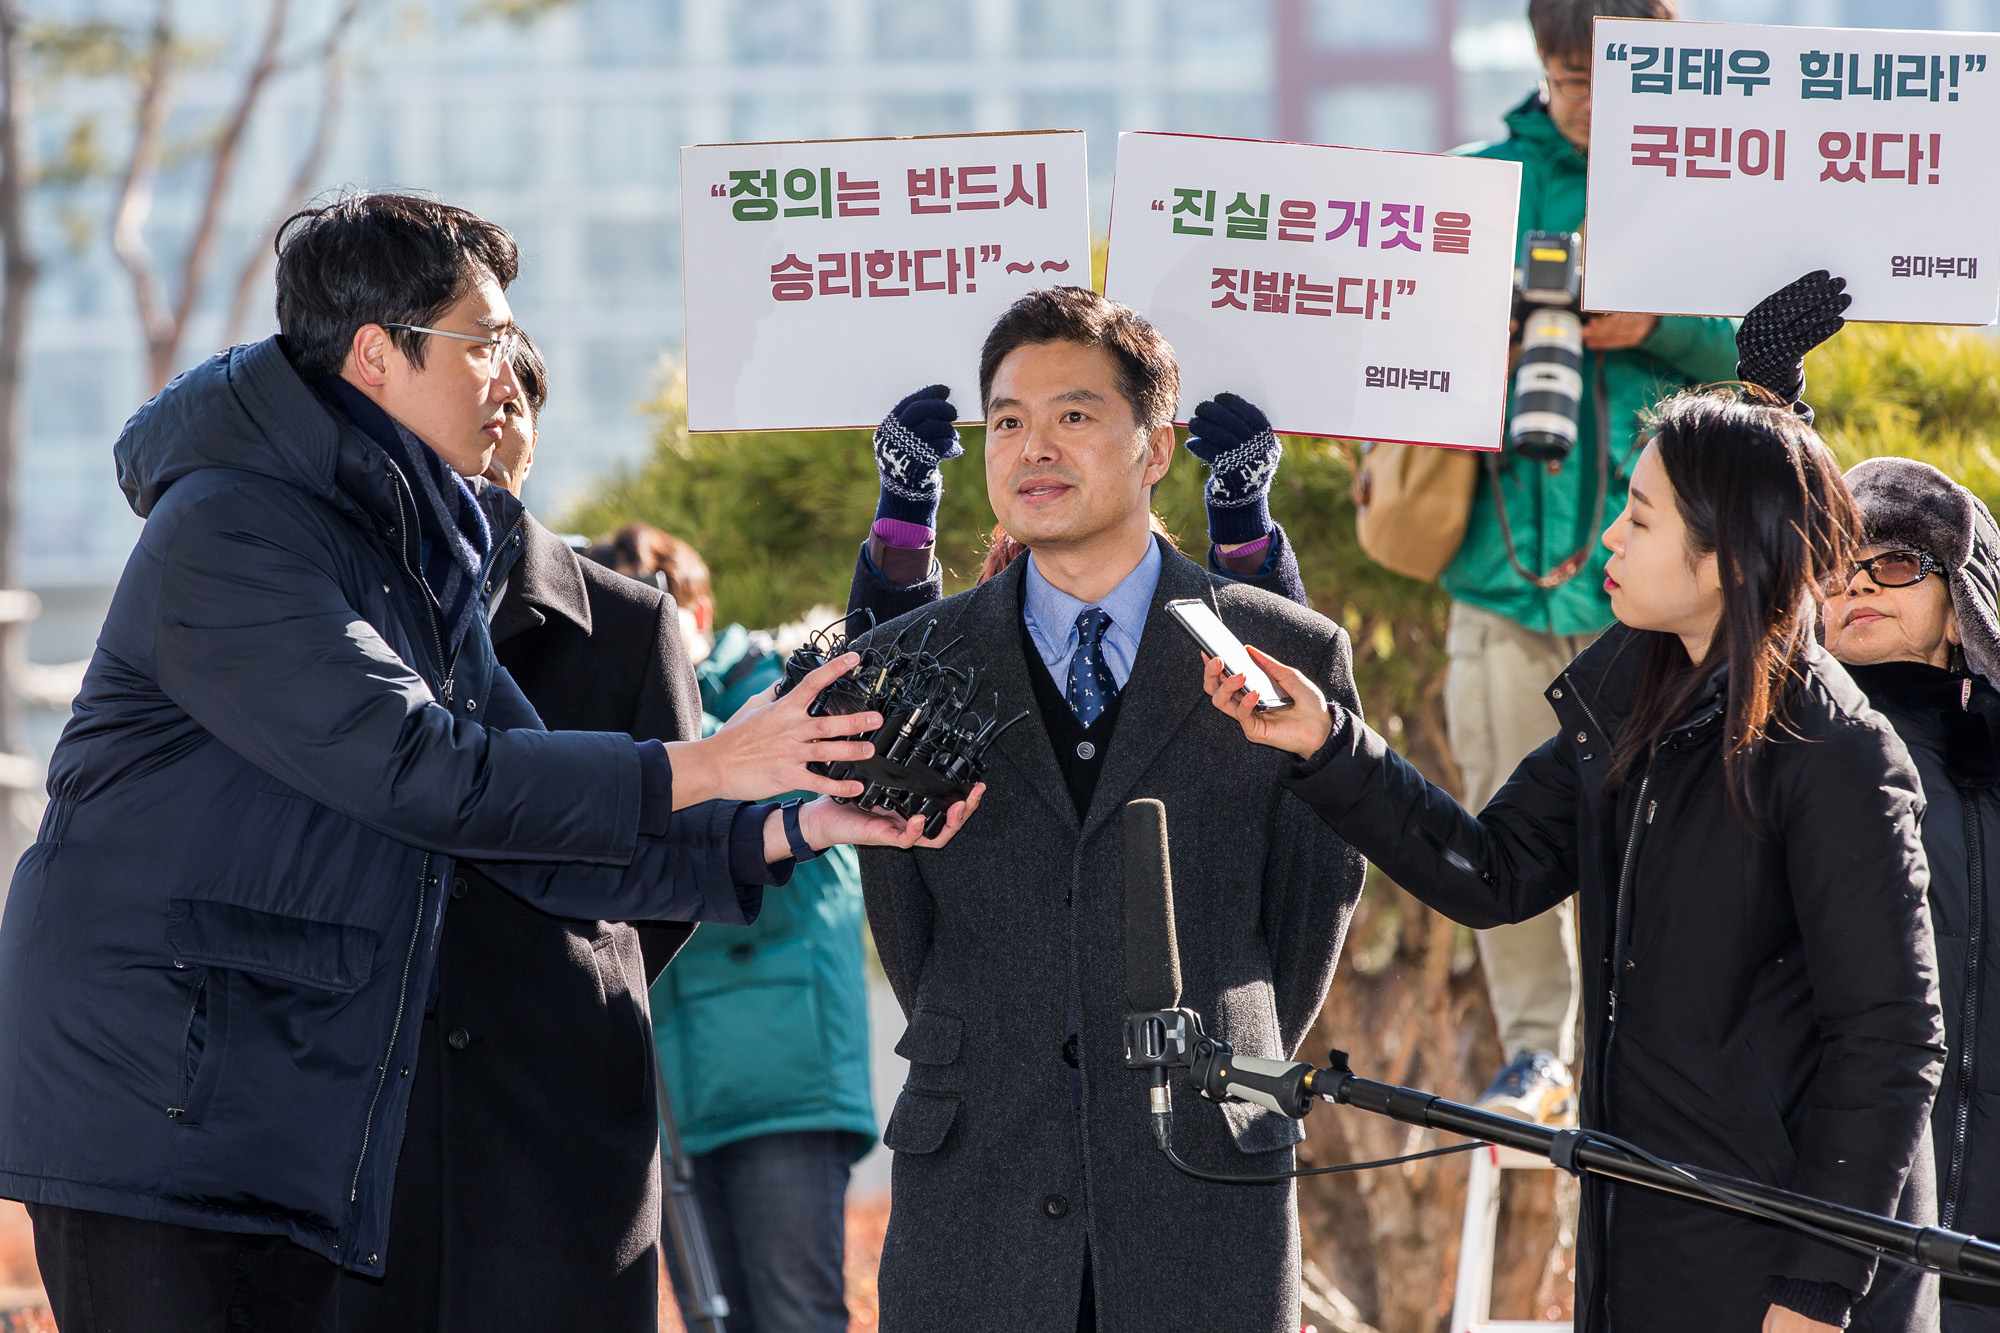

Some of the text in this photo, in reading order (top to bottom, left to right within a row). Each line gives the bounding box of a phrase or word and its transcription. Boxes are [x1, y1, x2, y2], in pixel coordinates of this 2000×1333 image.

[1605, 43, 1987, 102] “김태우 힘내라!”
[1630, 125, 1941, 185] 국민이 있다!
[711, 162, 1048, 221] “정의는 반드시
[1210, 267, 1417, 320] 짓밟는다!”
[1890, 255, 1978, 280] 엄마부대
[1364, 365, 1451, 392] 엄마부대
